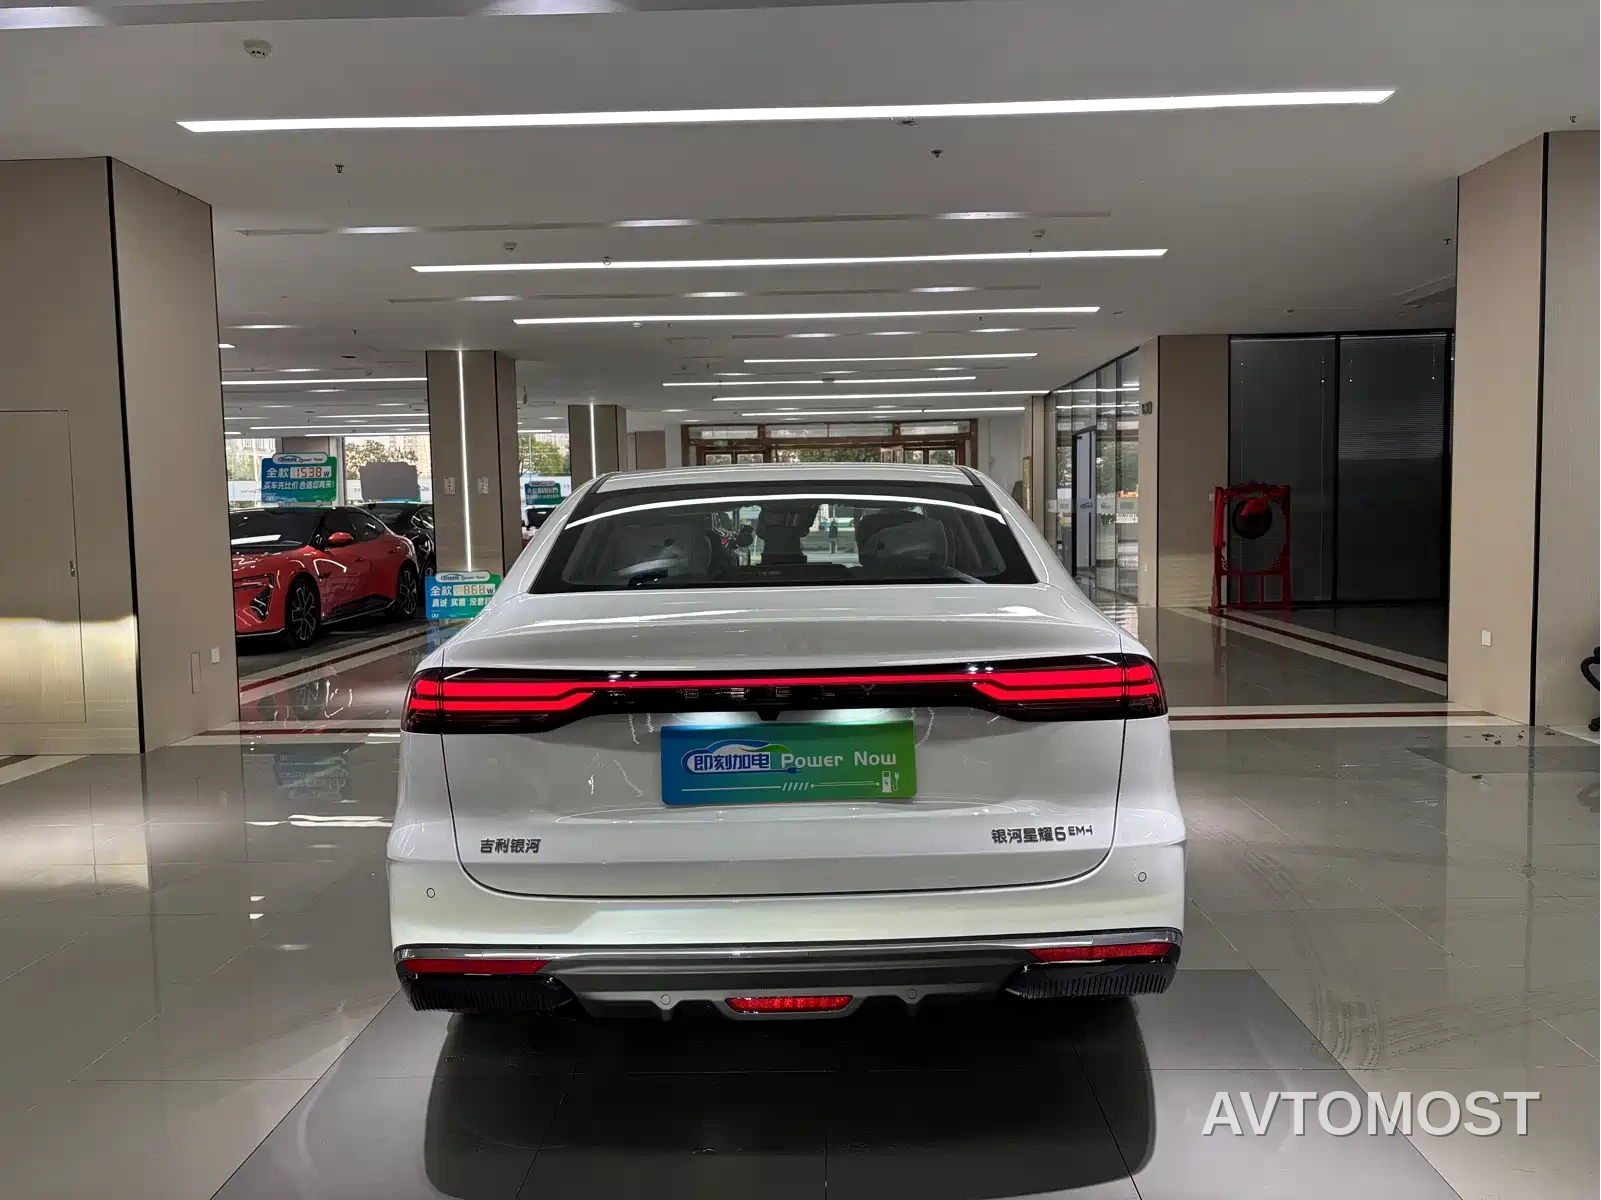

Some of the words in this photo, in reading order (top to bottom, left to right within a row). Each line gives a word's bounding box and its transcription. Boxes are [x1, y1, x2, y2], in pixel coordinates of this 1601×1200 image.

[266, 467, 289, 479] 全款
[430, 585, 452, 596] 全款
[693, 751, 770, 771] 即刻加电
[781, 753, 844, 769] Power
[854, 750, 897, 766] Now
[991, 826, 1067, 844] 银河星耀6
[480, 838, 542, 854] 吉利银河
